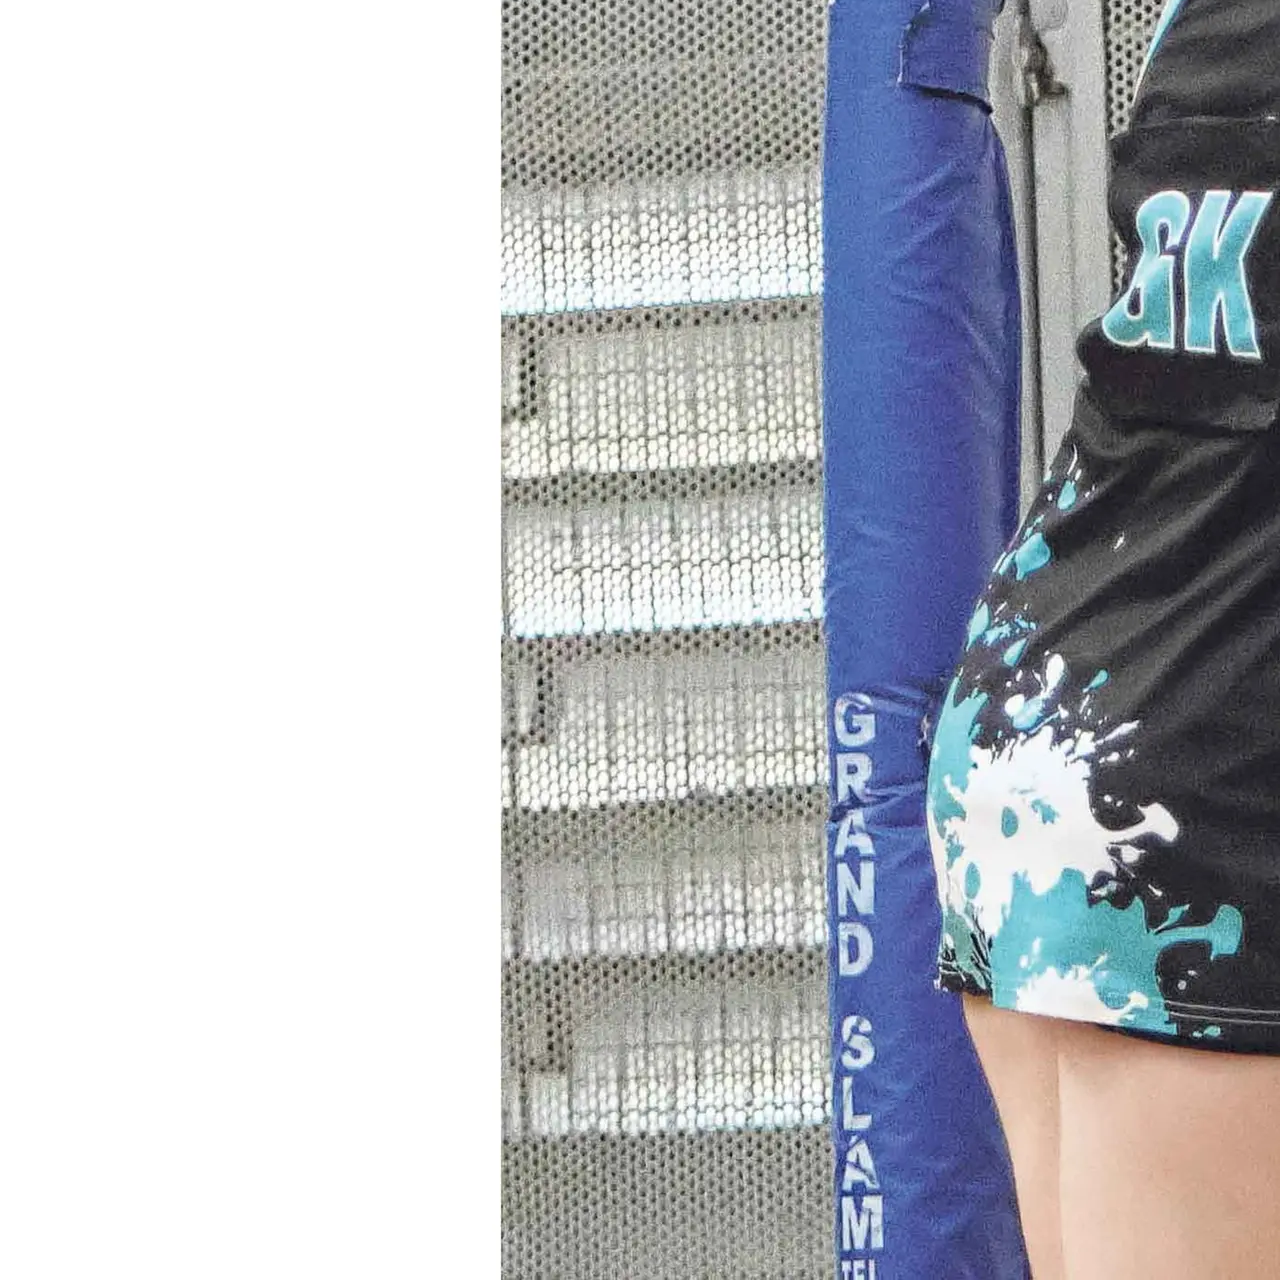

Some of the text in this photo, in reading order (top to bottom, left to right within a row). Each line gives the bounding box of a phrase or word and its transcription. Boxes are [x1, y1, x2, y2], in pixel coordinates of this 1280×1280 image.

[1102, 190, 1273, 359] GK
[834, 693, 884, 1252] GRAND SLAM
